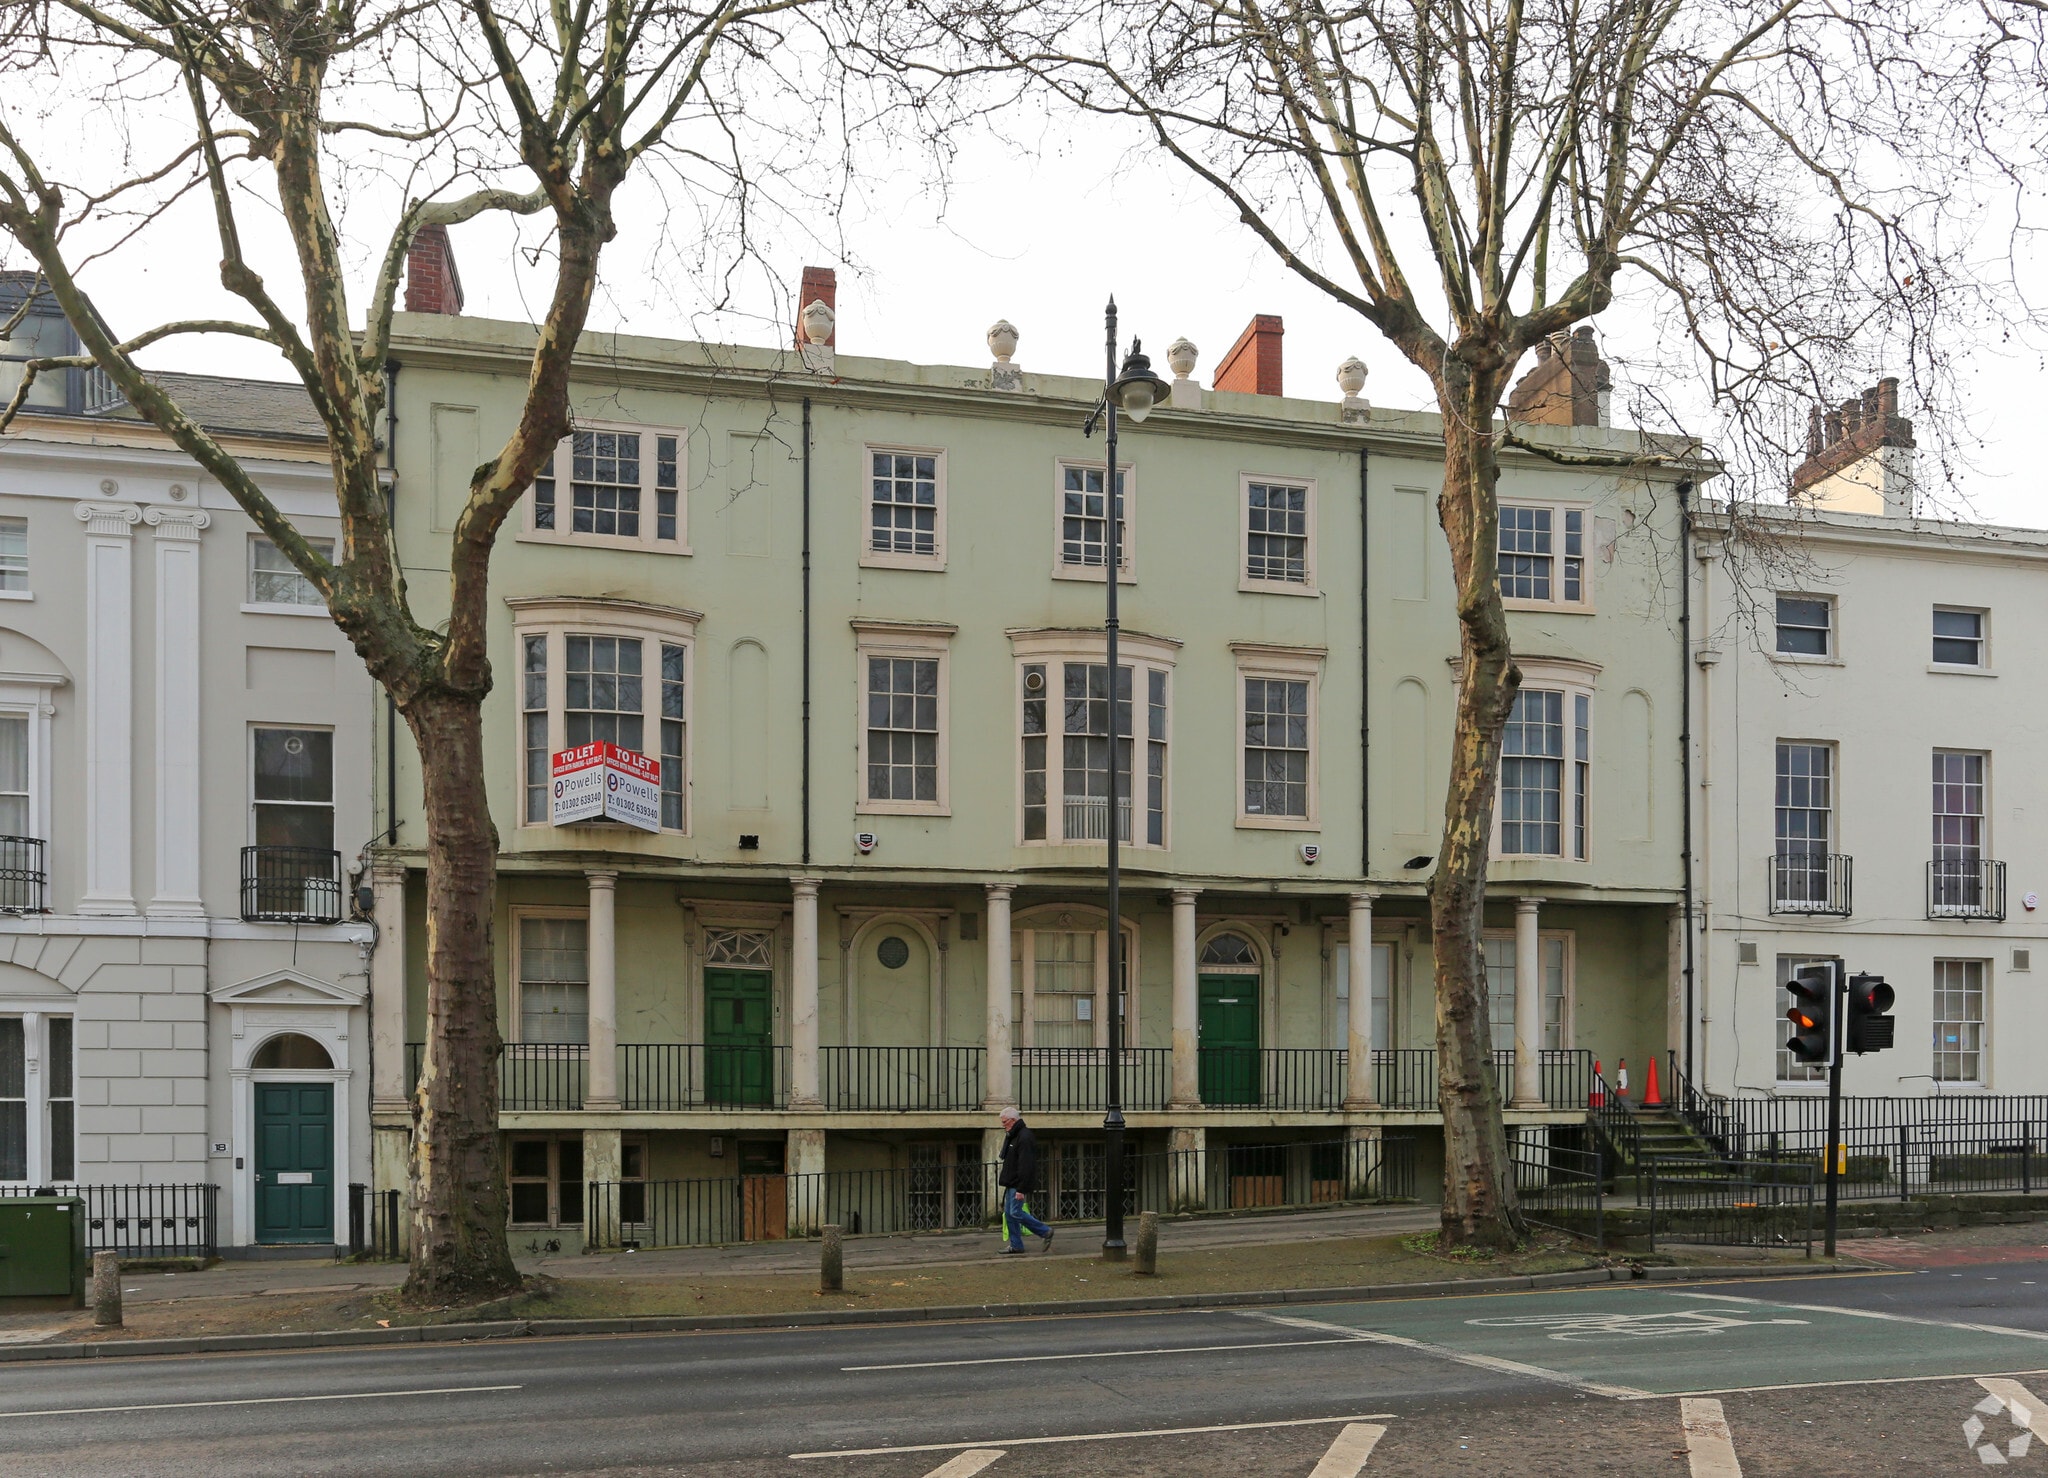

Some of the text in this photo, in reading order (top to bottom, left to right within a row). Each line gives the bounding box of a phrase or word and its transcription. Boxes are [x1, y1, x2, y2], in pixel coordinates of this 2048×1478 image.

[561, 751, 574, 764] TO
[577, 745, 595, 760] LET
[615, 748, 651, 771] TO LET
[564, 771, 602, 792] Powells
[619, 777, 658, 803] Powells
[554, 792, 602, 812] T: 01302 639340
[607, 793, 658, 819] T: 01302 639340
[215, 1143, 226, 1152] 18
[25, 1212, 31, 1220] 7
